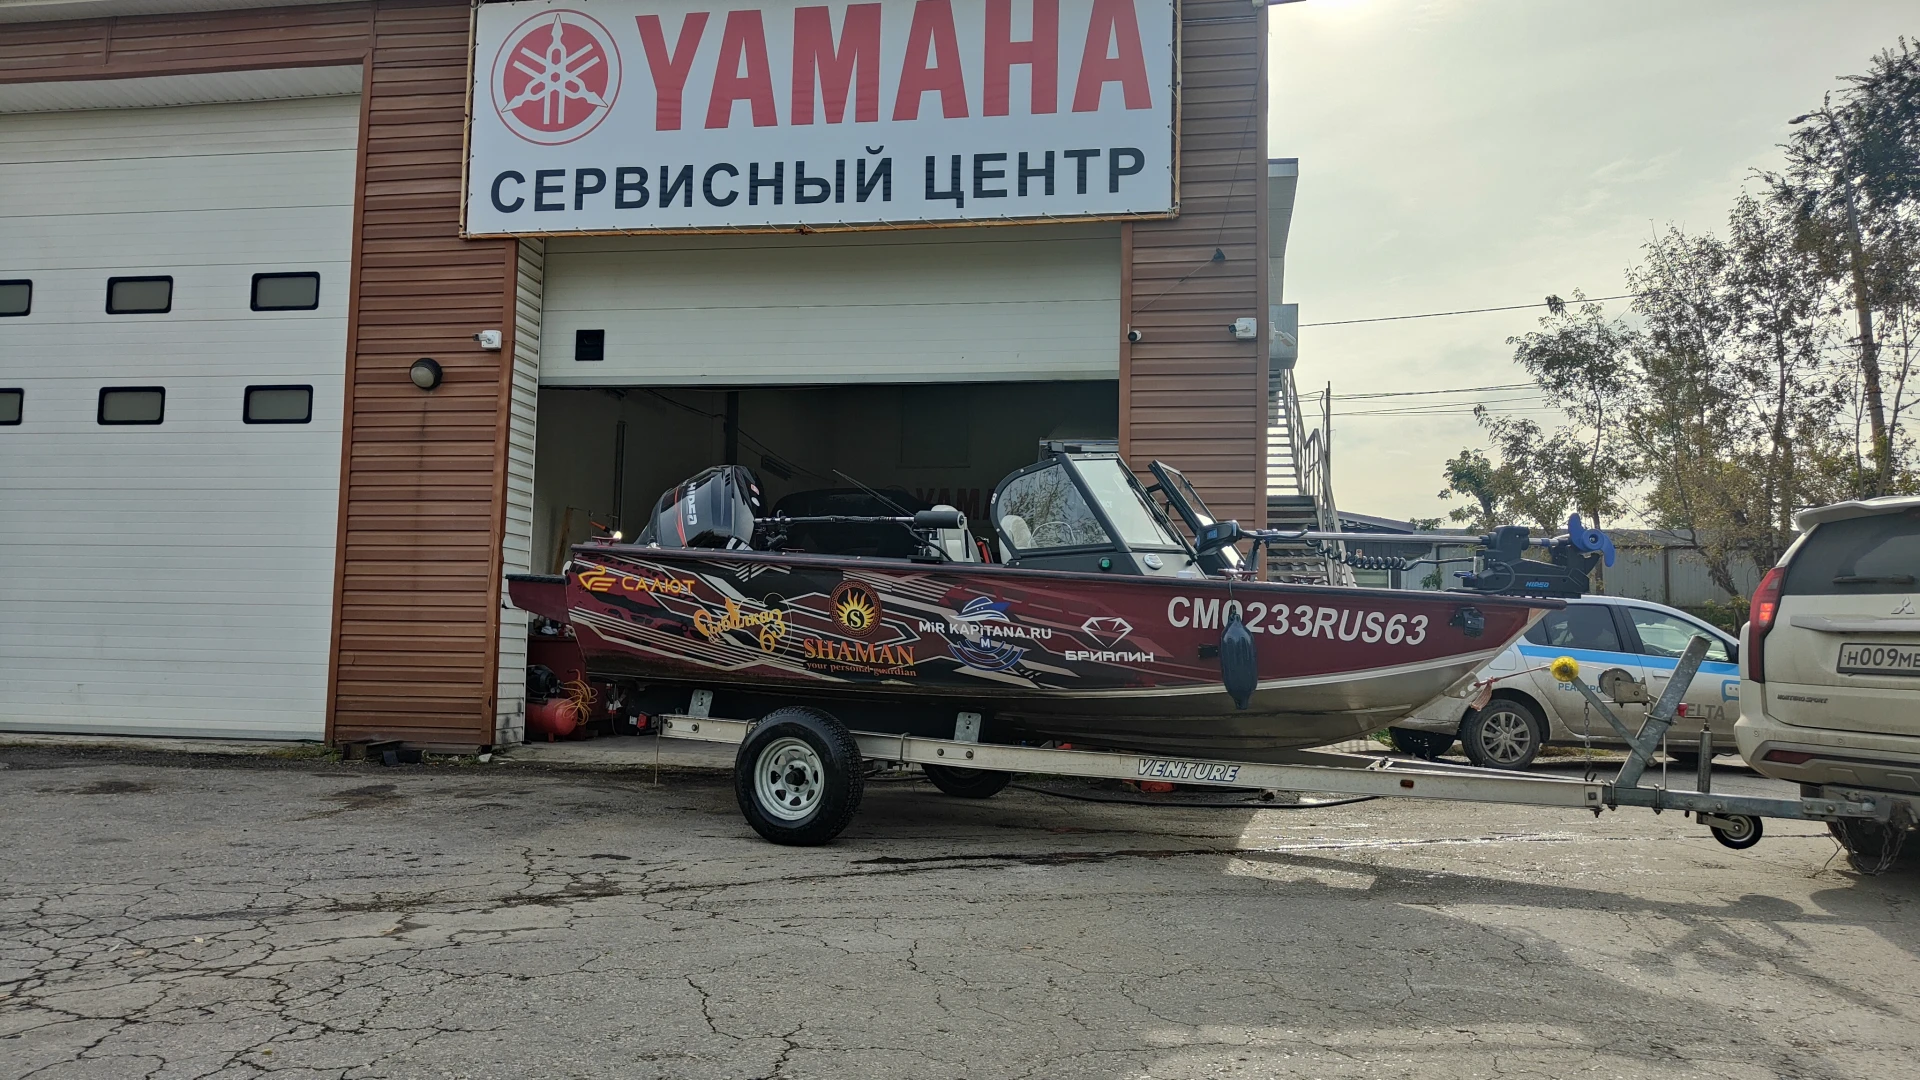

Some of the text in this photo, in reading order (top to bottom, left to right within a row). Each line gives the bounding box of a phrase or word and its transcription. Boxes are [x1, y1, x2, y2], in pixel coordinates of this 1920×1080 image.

[635, 0, 1152, 131] YAMAHA
[490, 146, 1146, 214] СЕРВИСНЫЙ ЦЕНТР
[622, 576, 696, 595] САЛЮТ
[803, 638, 915, 666] SHAMAN
[806, 662, 917, 677] your personal guardian
[1138, 759, 1241, 782] VENTURE
